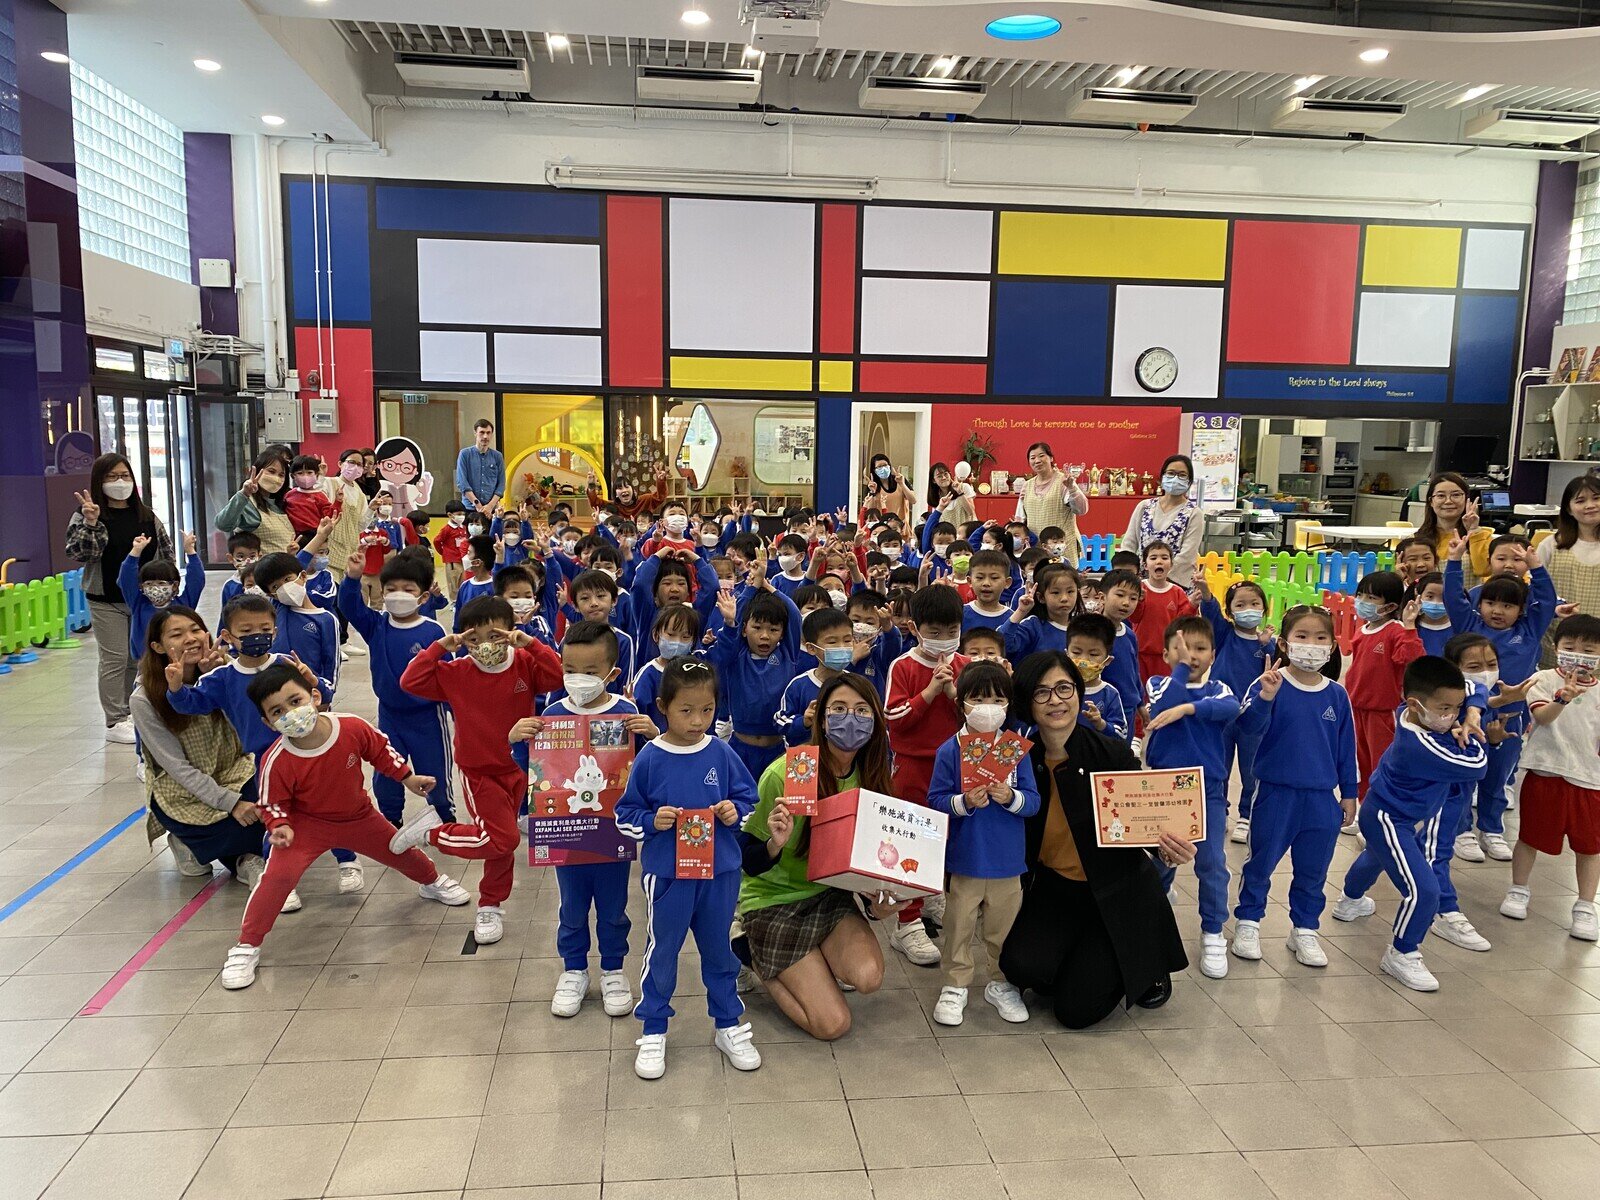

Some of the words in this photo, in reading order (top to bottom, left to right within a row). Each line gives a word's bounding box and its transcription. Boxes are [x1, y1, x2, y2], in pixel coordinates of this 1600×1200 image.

[1288, 377, 1316, 387] Rejoice
[1318, 377, 1326, 386] in
[1329, 377, 1341, 386] the
[1343, 378, 1361, 387] Lord
[1363, 378, 1387, 388] always
[973, 418, 1007, 429] Through
[1010, 419, 1029, 428] Love
[1032, 419, 1042, 428] be
[1045, 419, 1077, 429] servants
[1097, 420, 1106, 428] to
[1108, 420, 1139, 429] another
[881, 824, 916, 840] 收集大行動
